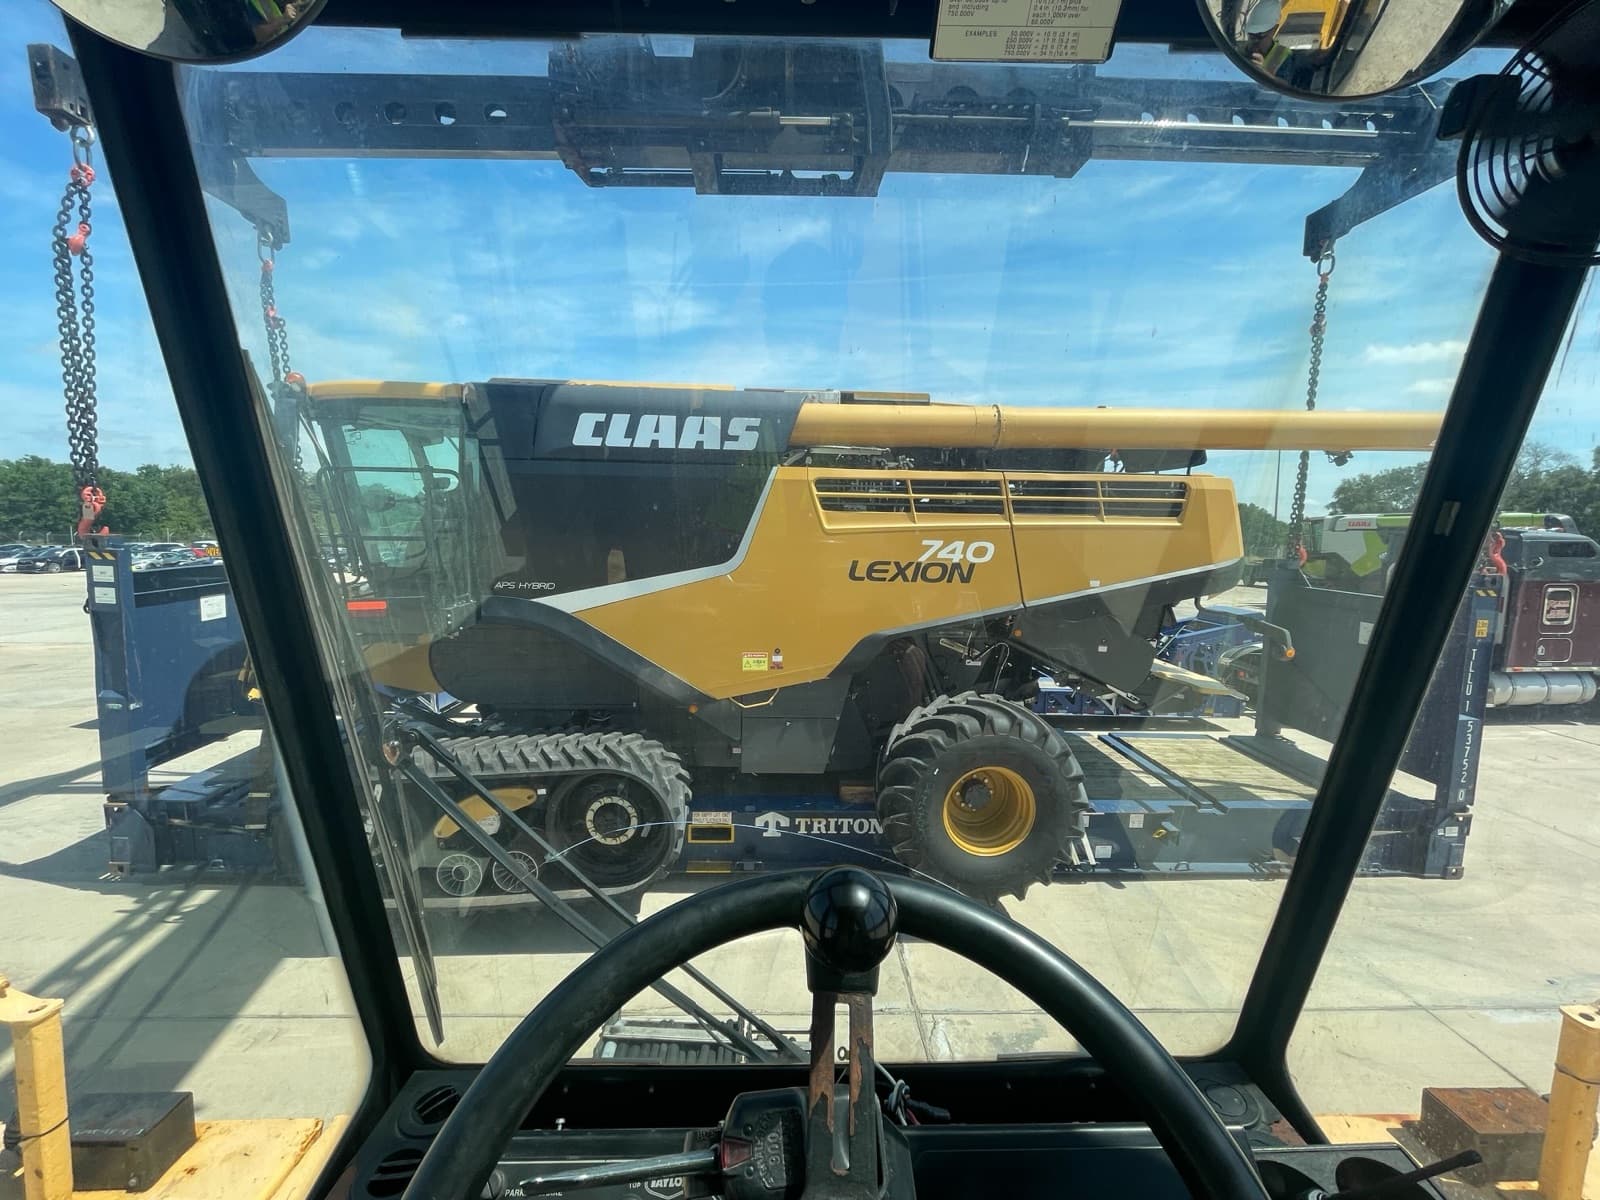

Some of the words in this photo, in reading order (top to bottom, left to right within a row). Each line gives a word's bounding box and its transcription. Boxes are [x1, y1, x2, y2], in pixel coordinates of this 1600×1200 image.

[961, 3, 989, 11] including
[572, 412, 762, 451] CLAAS
[918, 539, 995, 564] 740
[848, 560, 976, 584] LEXION
[494, 581, 516, 589] APS
[519, 582, 556, 590] HYBRID
[795, 818, 884, 834] TRITON
